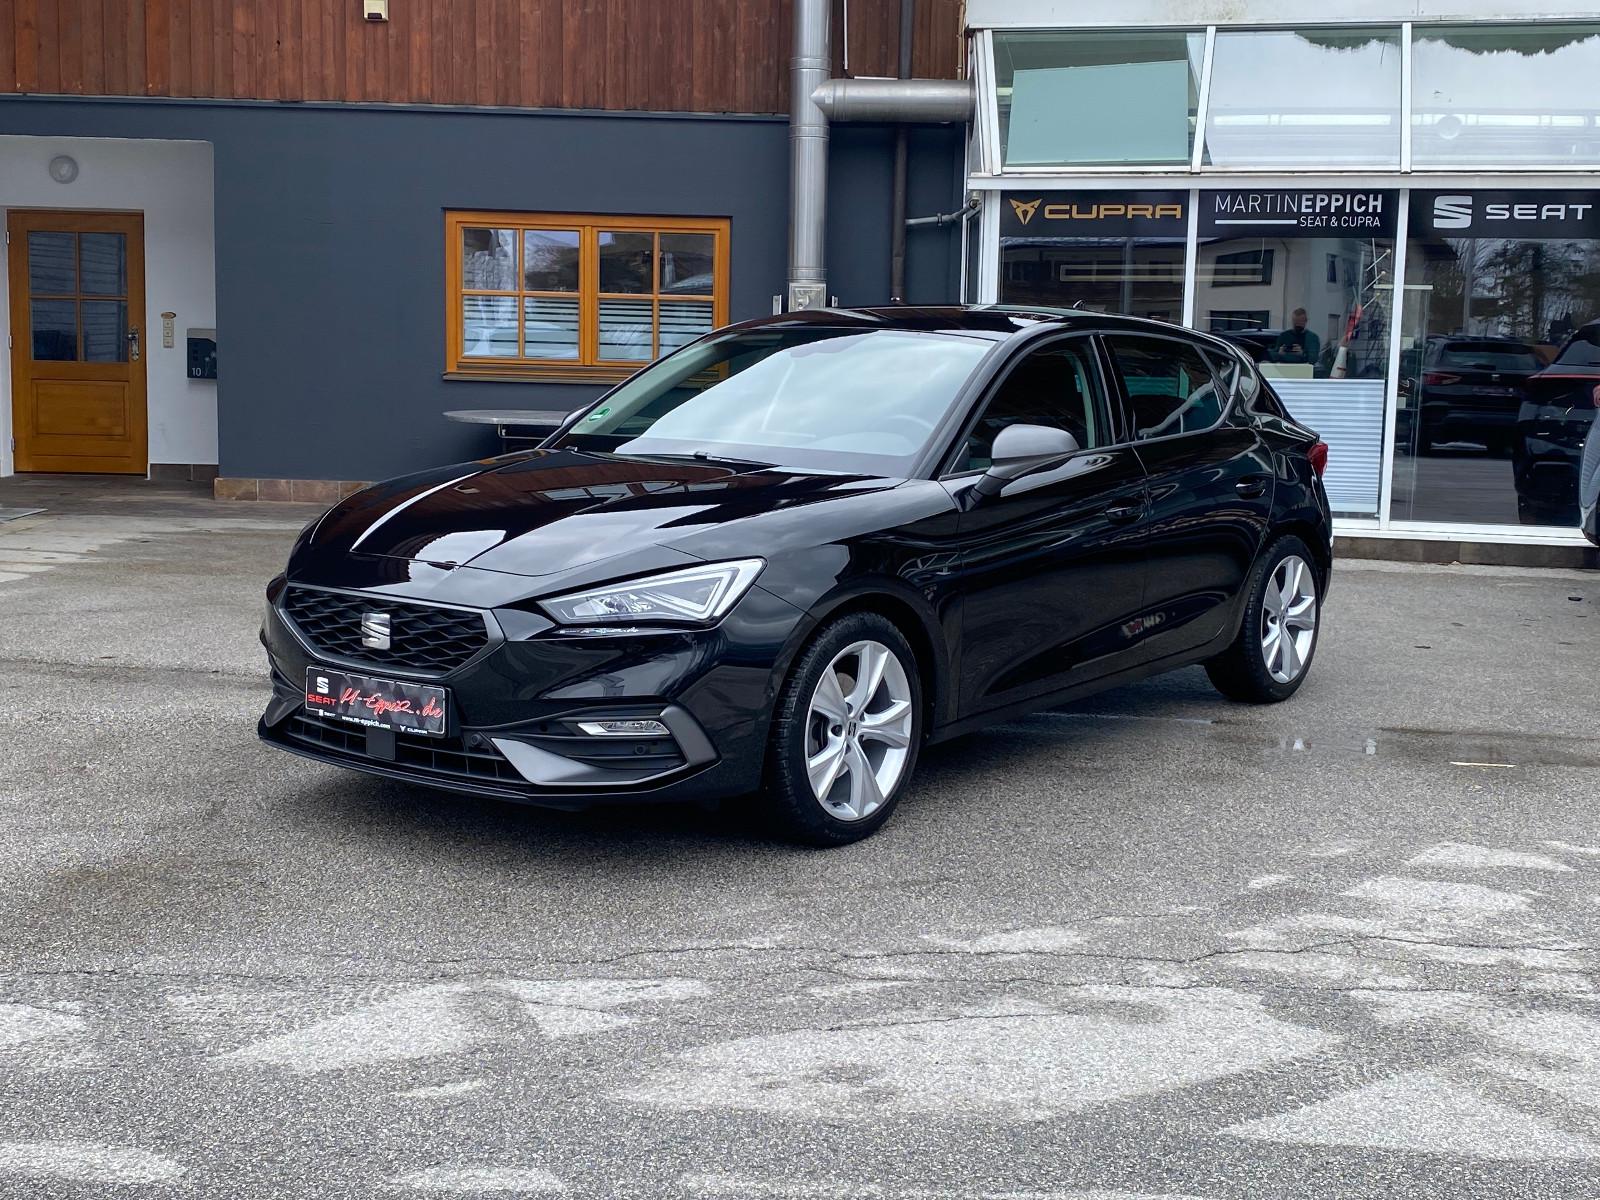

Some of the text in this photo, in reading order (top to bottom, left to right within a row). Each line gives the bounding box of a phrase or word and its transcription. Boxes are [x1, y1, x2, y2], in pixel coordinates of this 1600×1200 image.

[1043, 204, 1182, 219] CUPRA
[1485, 204, 1593, 220] SEAT
[1299, 216, 1381, 227] SEAT & CUPRA
[191, 367, 202, 377] 10
[307, 693, 337, 706] SEAT
